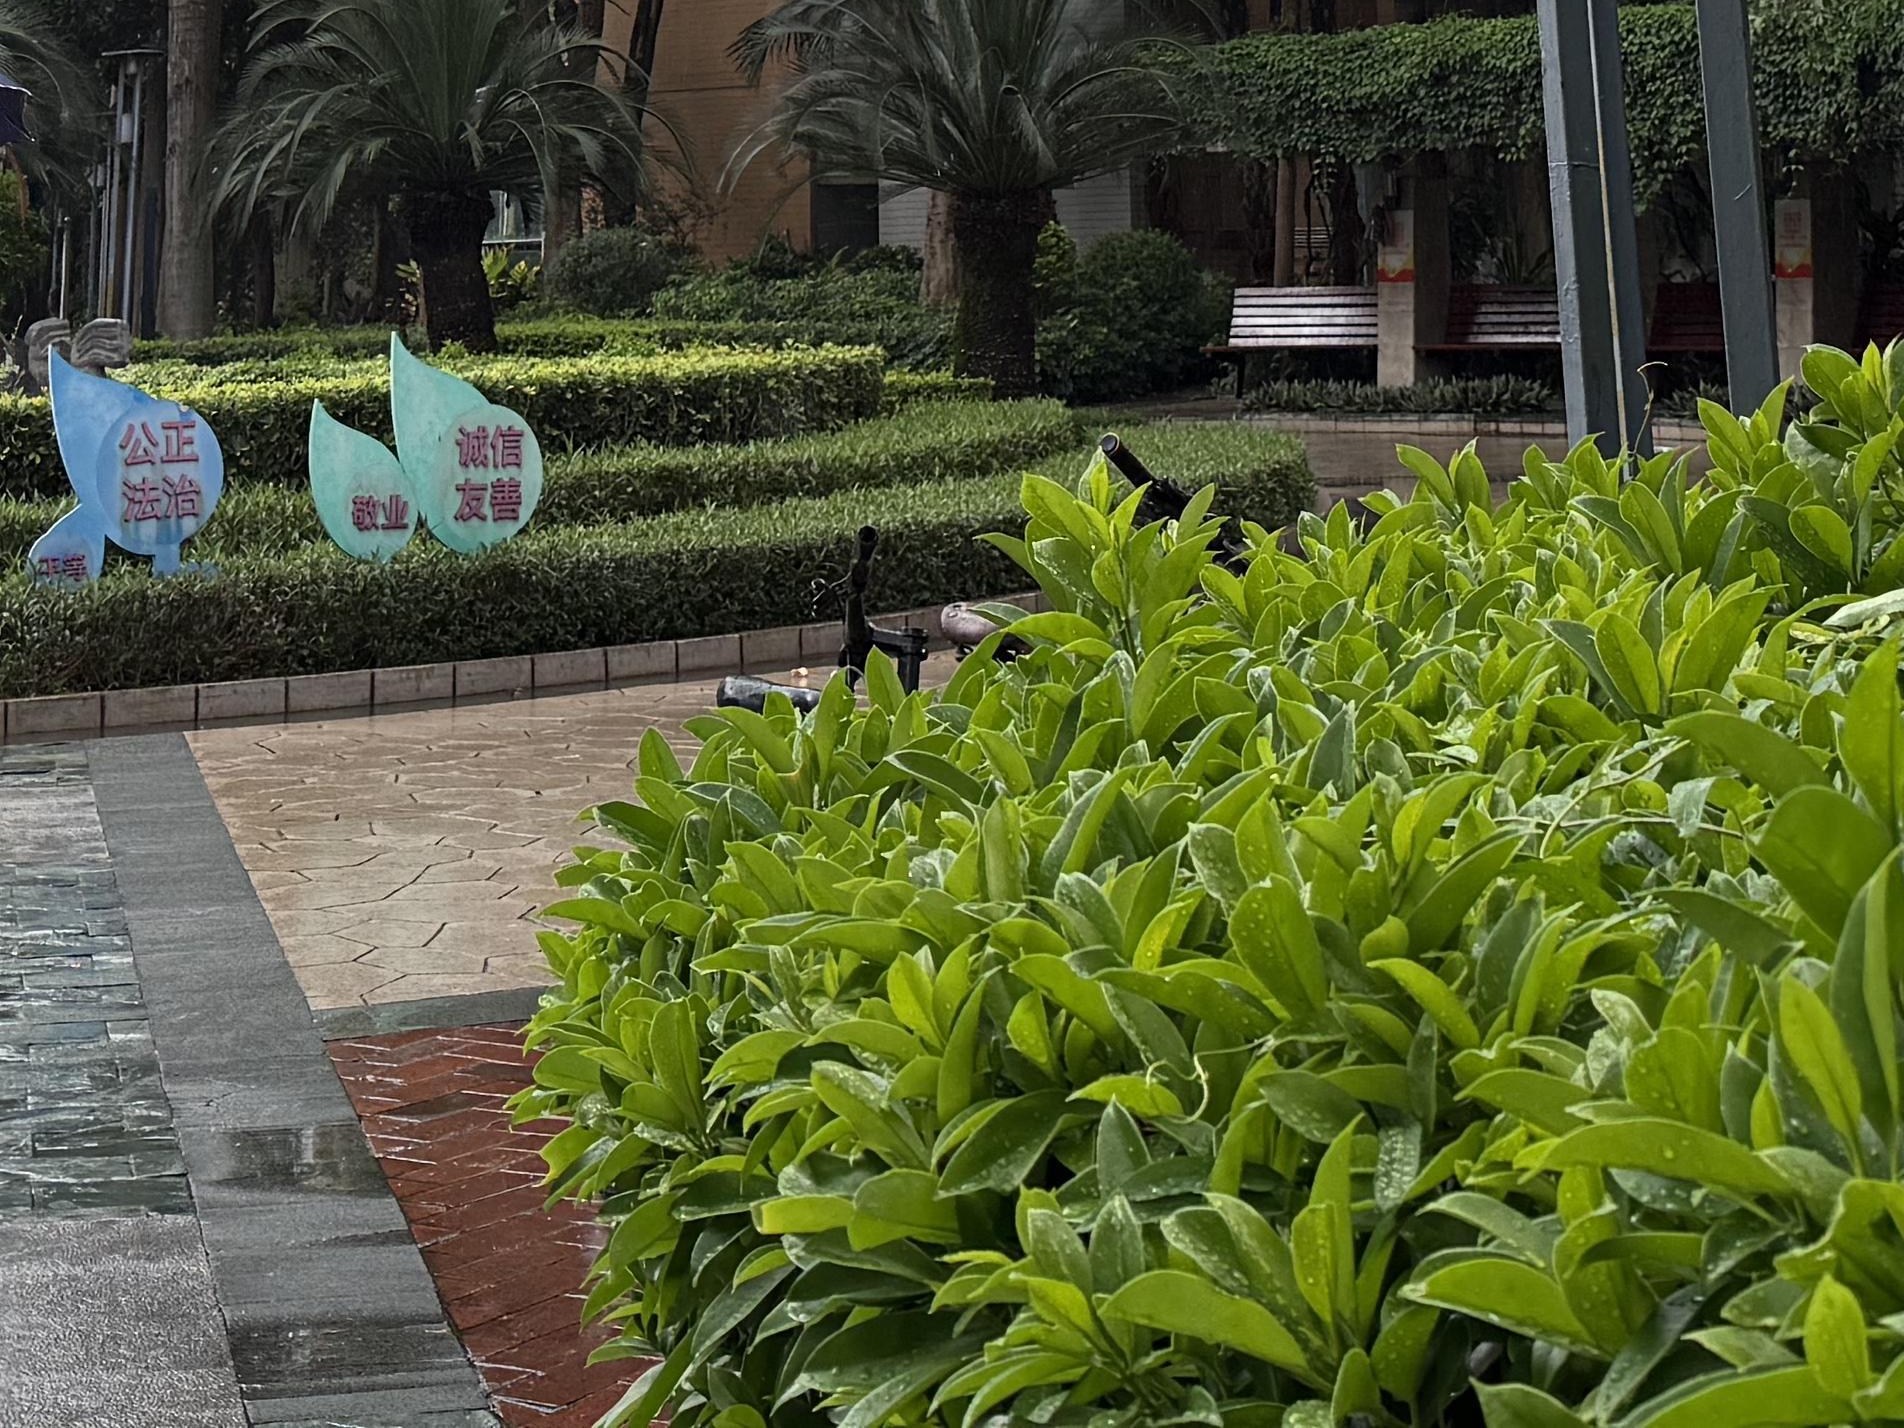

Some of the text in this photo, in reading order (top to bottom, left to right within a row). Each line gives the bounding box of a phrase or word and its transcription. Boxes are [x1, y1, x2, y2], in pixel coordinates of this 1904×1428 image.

[119, 420, 200, 467] 公正
[457, 425, 524, 469] 诚信
[122, 473, 201, 522] 法治
[352, 495, 409, 531] 敬业
[454, 478, 523, 523] 友善
